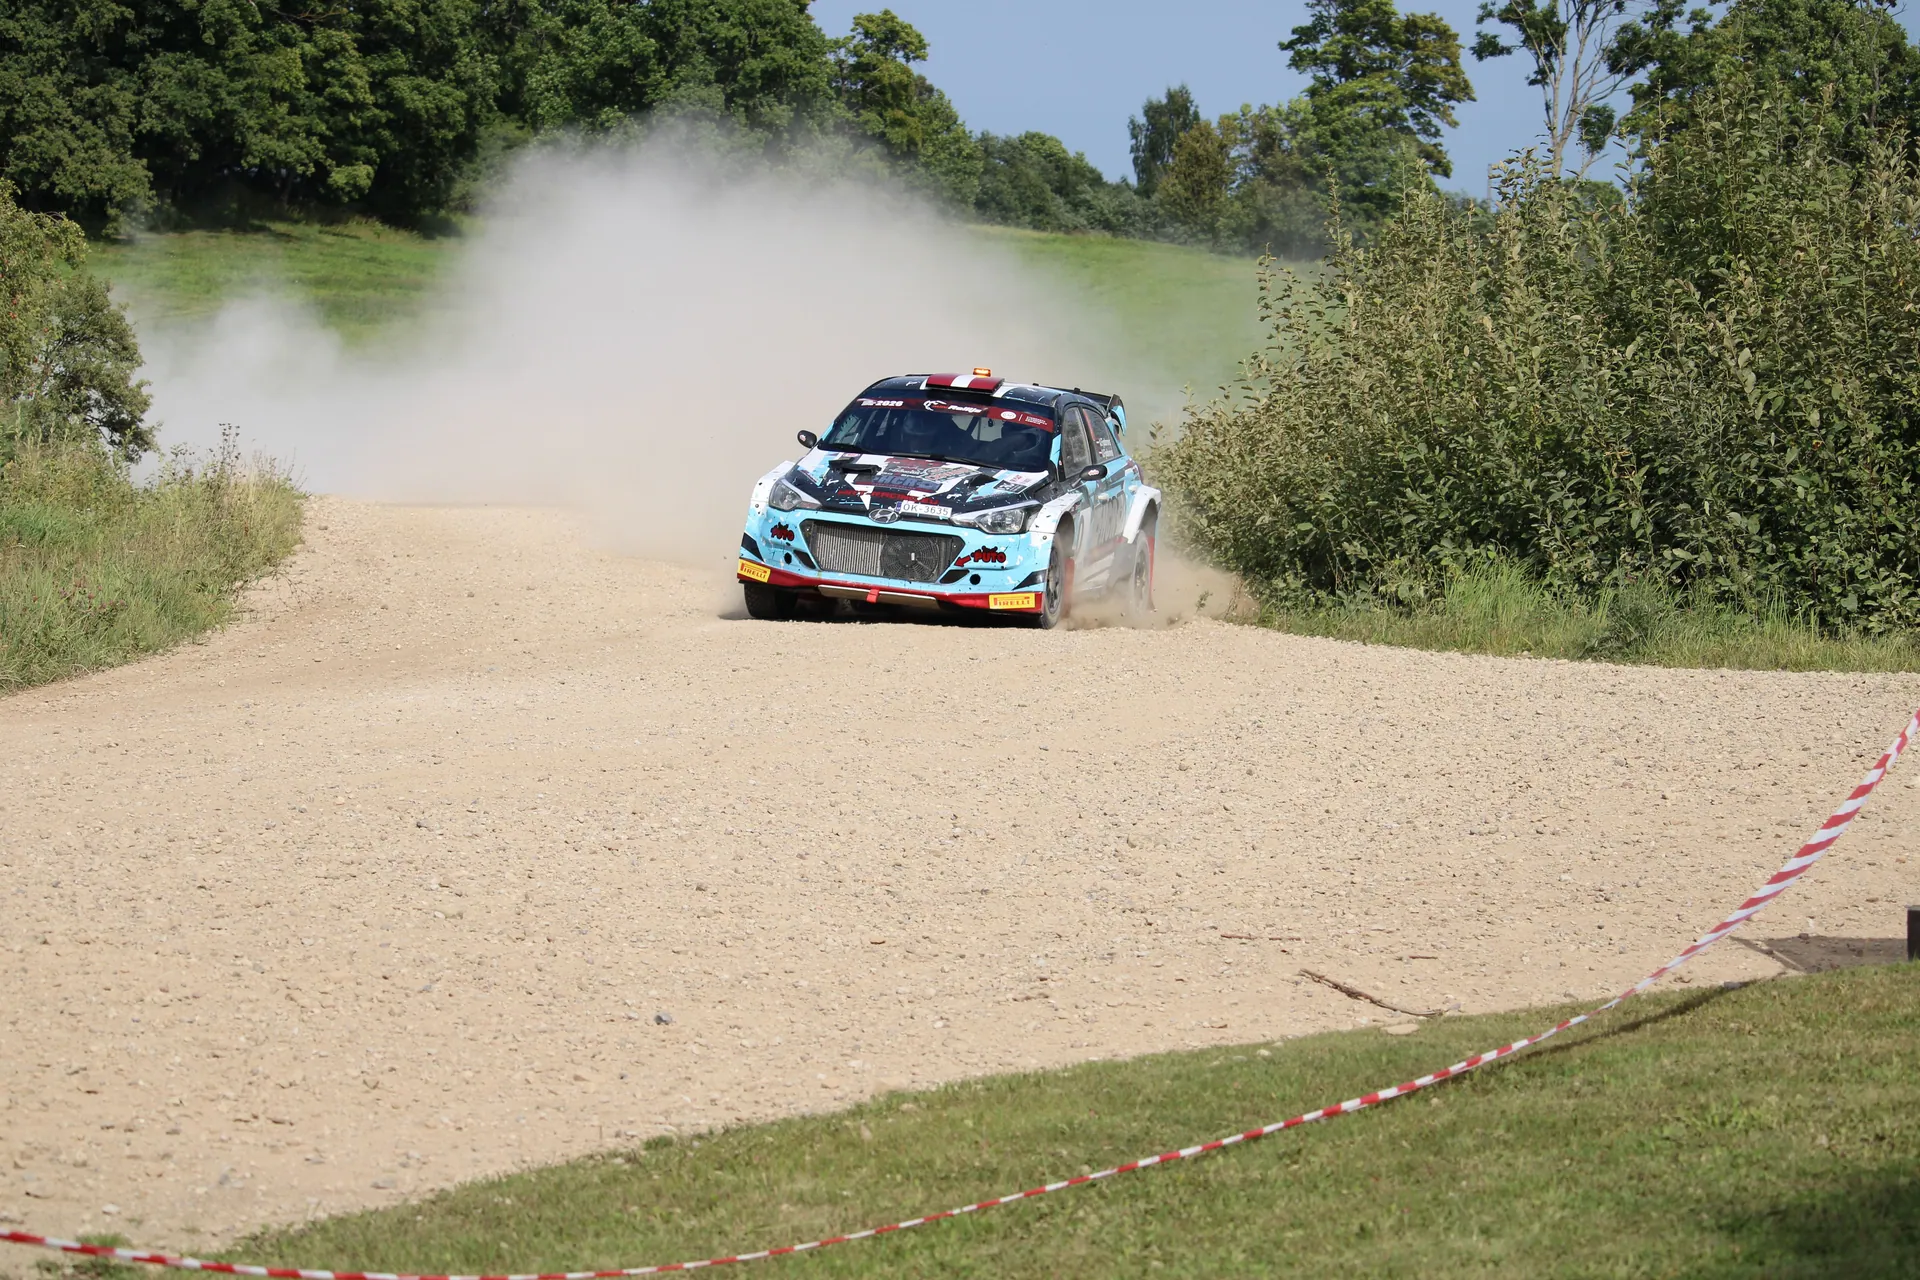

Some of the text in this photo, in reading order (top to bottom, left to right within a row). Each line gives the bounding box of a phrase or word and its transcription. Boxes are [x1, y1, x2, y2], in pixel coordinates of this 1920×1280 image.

[903, 503, 949, 516] OK-3635
[740, 562, 767, 579] PIRELLI
[993, 597, 1031, 606] PIRELLI
